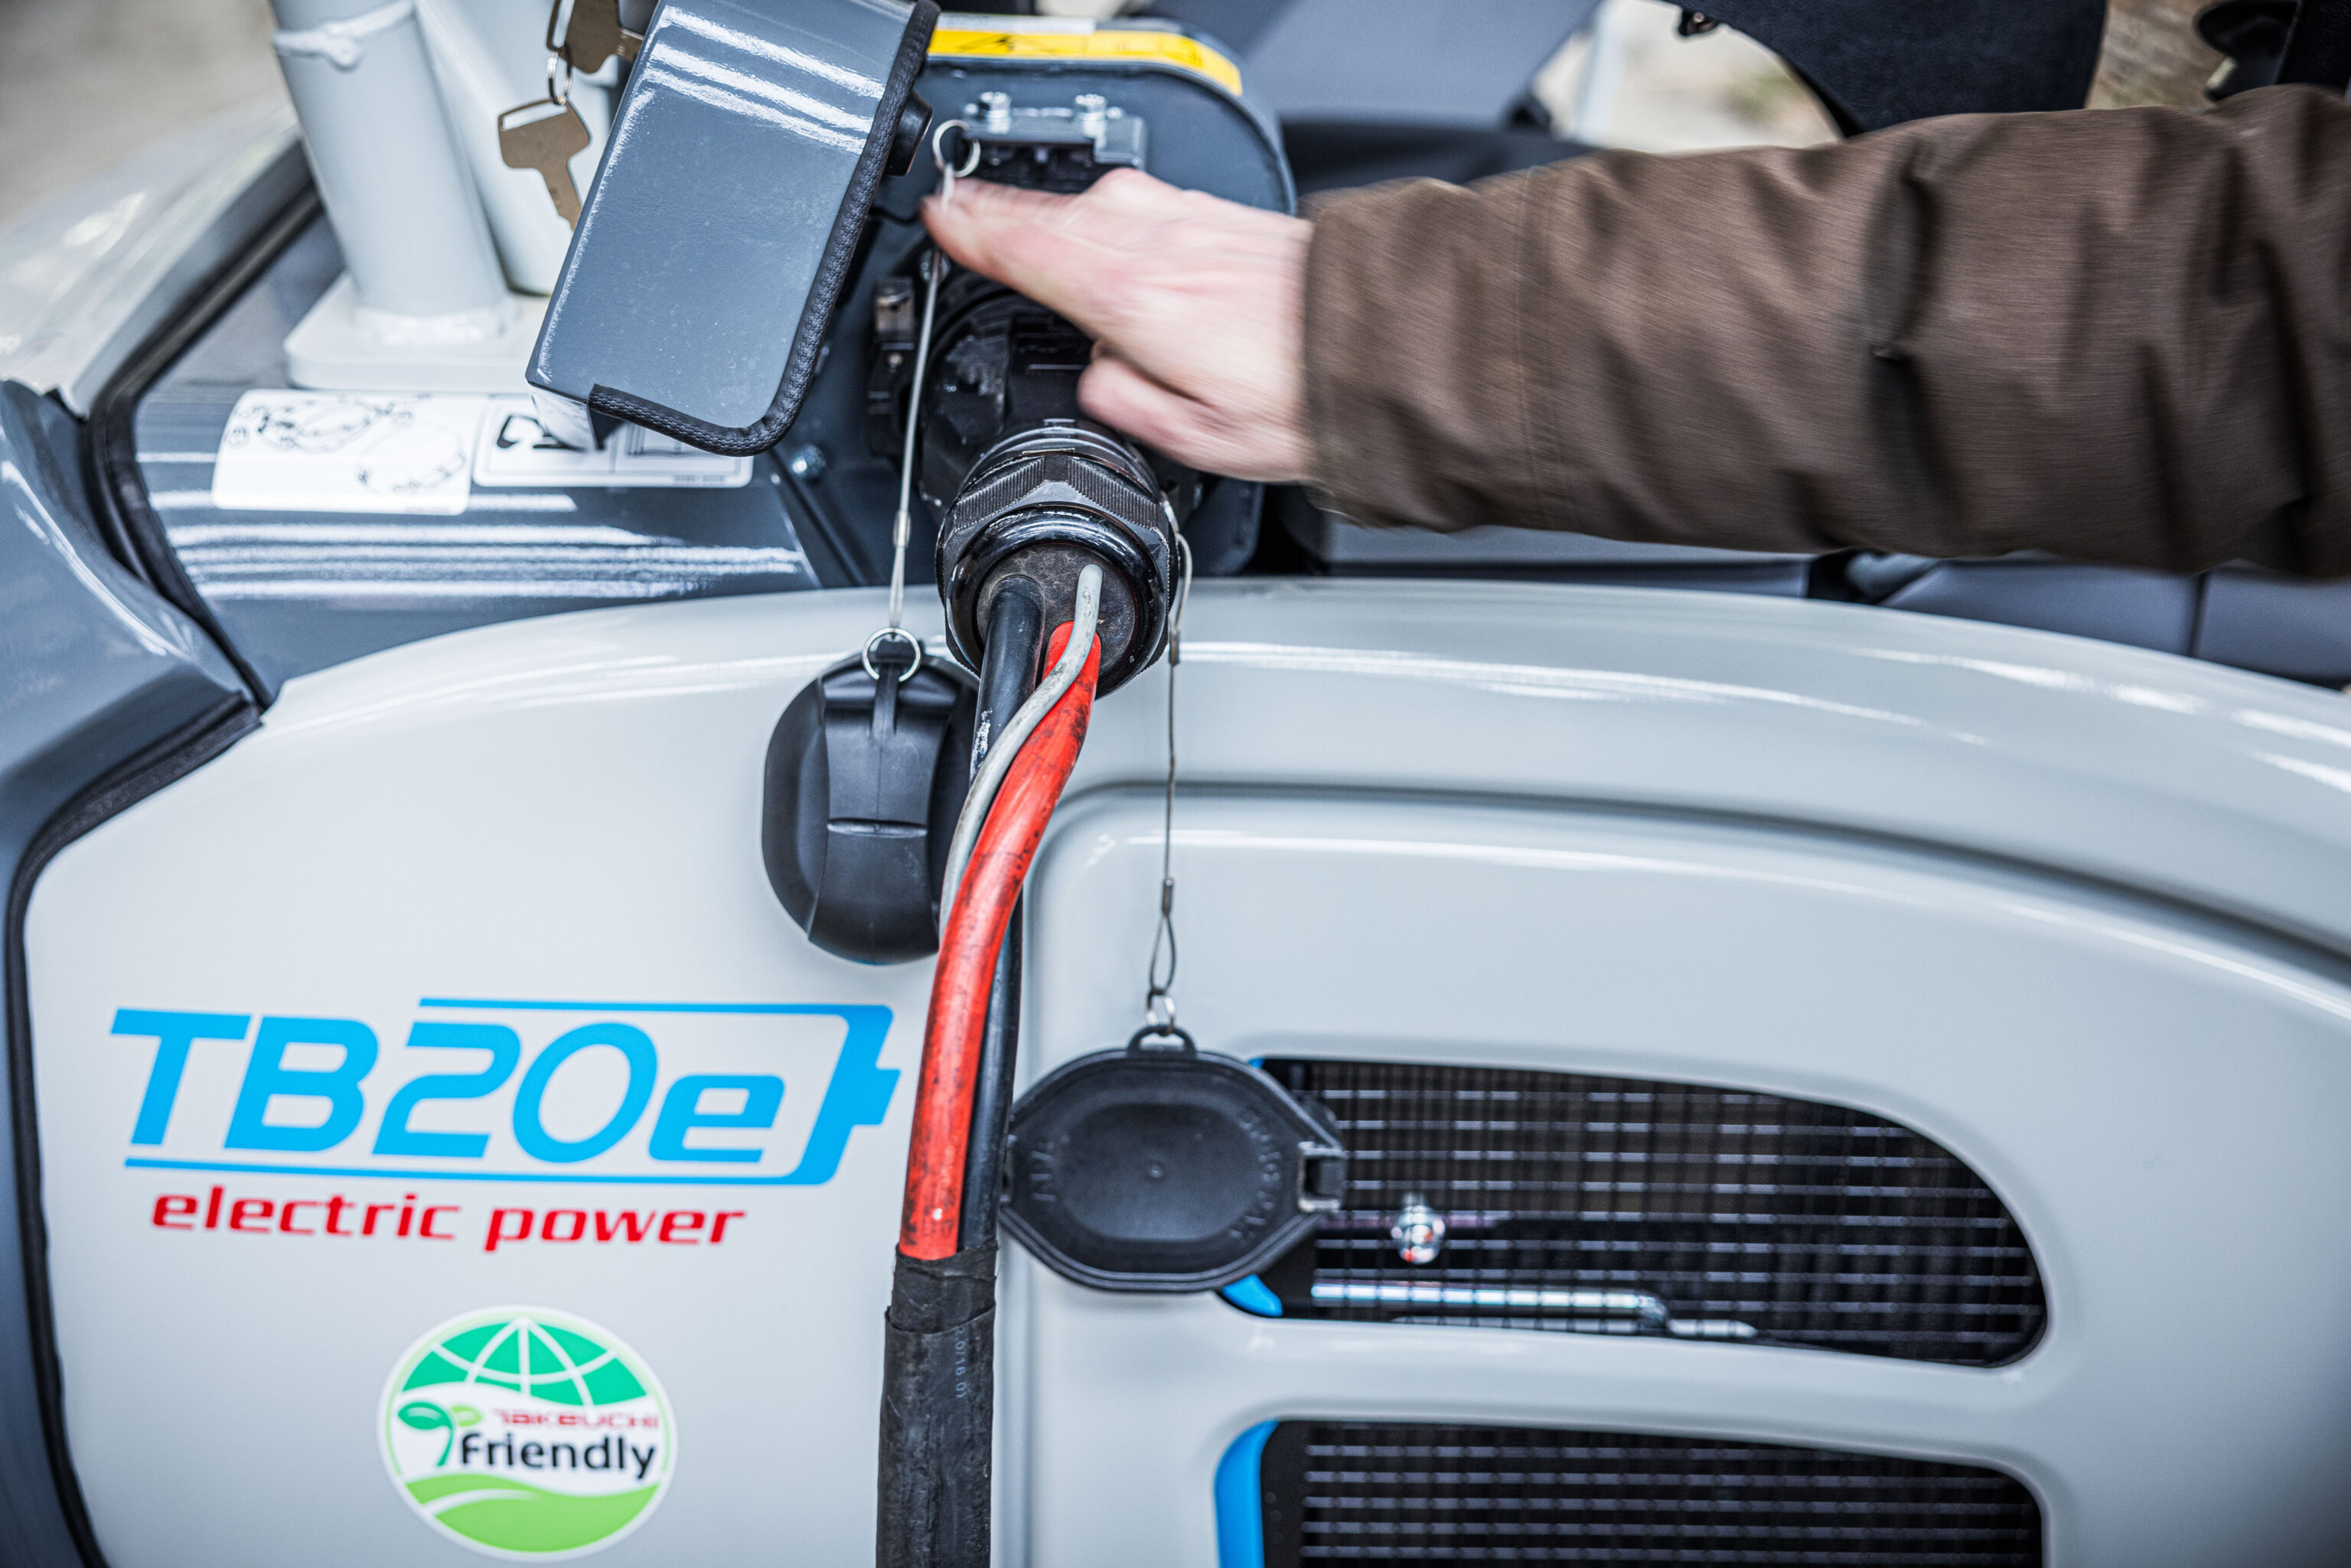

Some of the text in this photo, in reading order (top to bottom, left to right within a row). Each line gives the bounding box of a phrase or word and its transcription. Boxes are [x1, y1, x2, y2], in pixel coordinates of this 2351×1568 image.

[110, 1009, 785, 1163] TB20e
[152, 1185, 746, 1253] electric power
